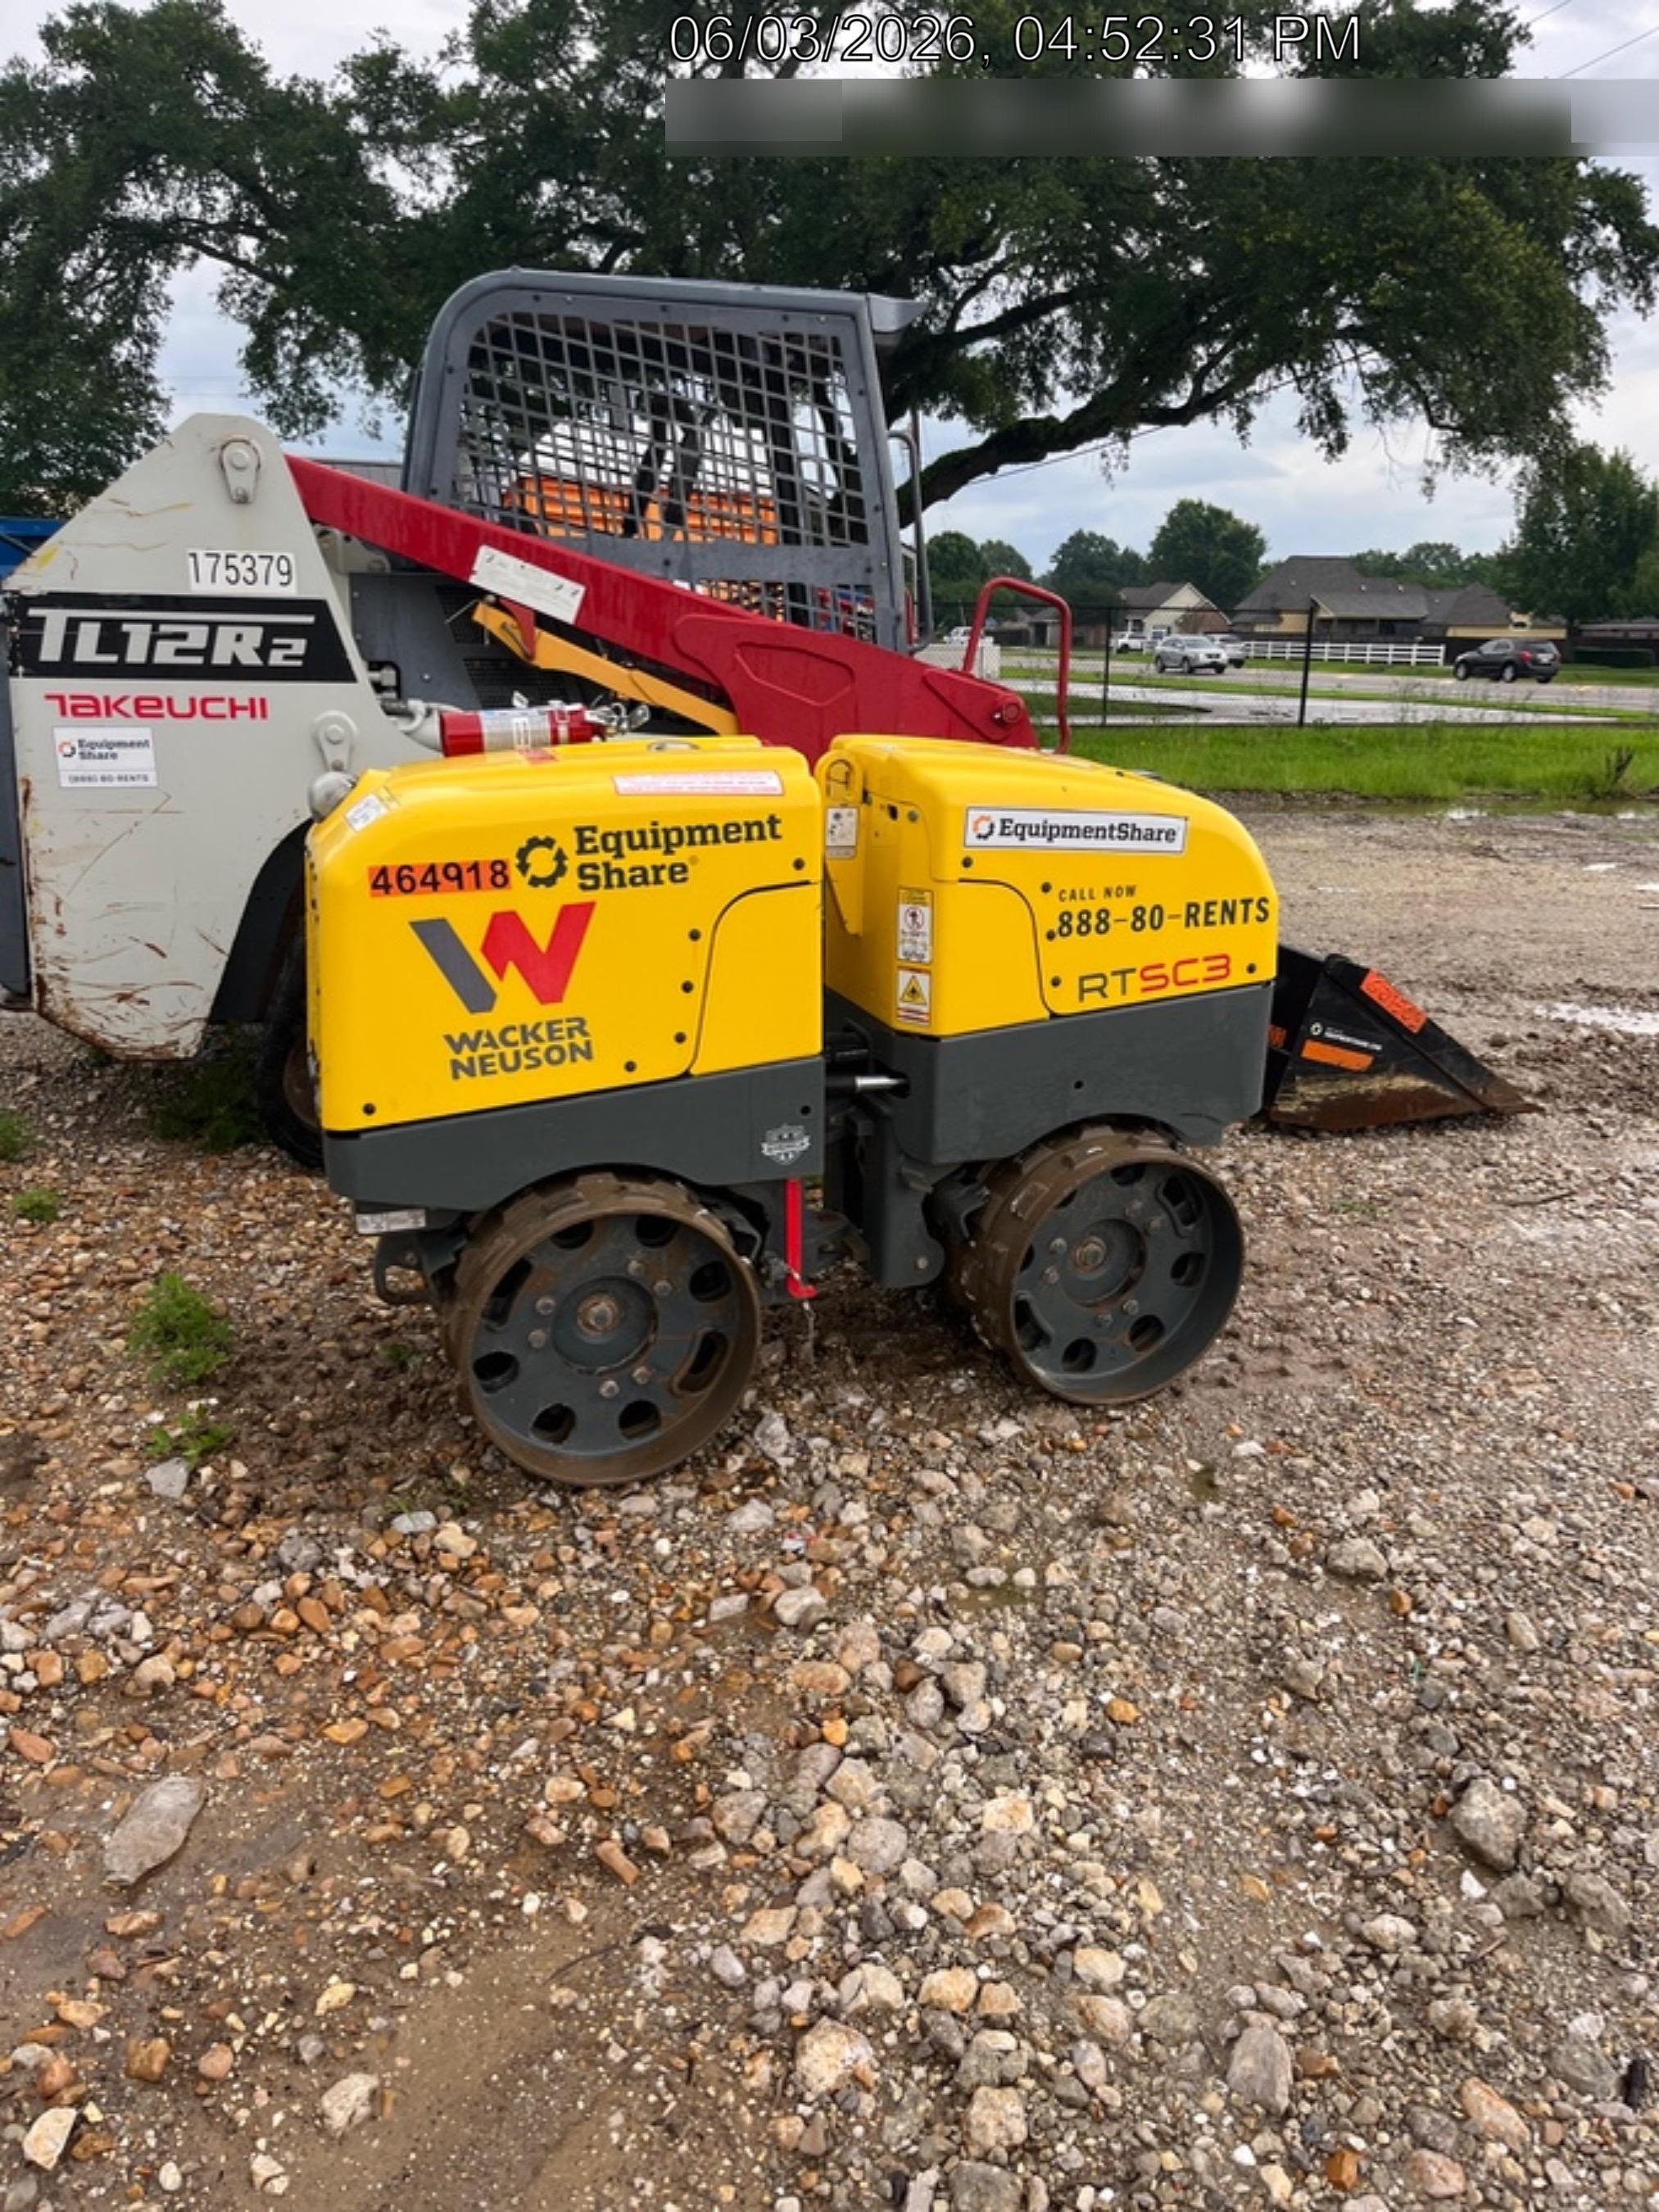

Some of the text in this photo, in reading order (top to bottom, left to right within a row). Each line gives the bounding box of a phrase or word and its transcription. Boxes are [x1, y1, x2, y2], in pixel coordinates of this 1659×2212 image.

[188, 552, 293, 587] 175379
[573, 814, 782, 859] Equipment
[999, 818, 1176, 843] EquipmentShare
[370, 859, 510, 895] 464918
[578, 860, 689, 891] Share
[1058, 884, 1137, 903] CALL NOW
[1058, 897, 1270, 938] 888-80-RENTS
[443, 1016, 592, 1055] WACKER
[450, 1040, 594, 1081] NEUSON
